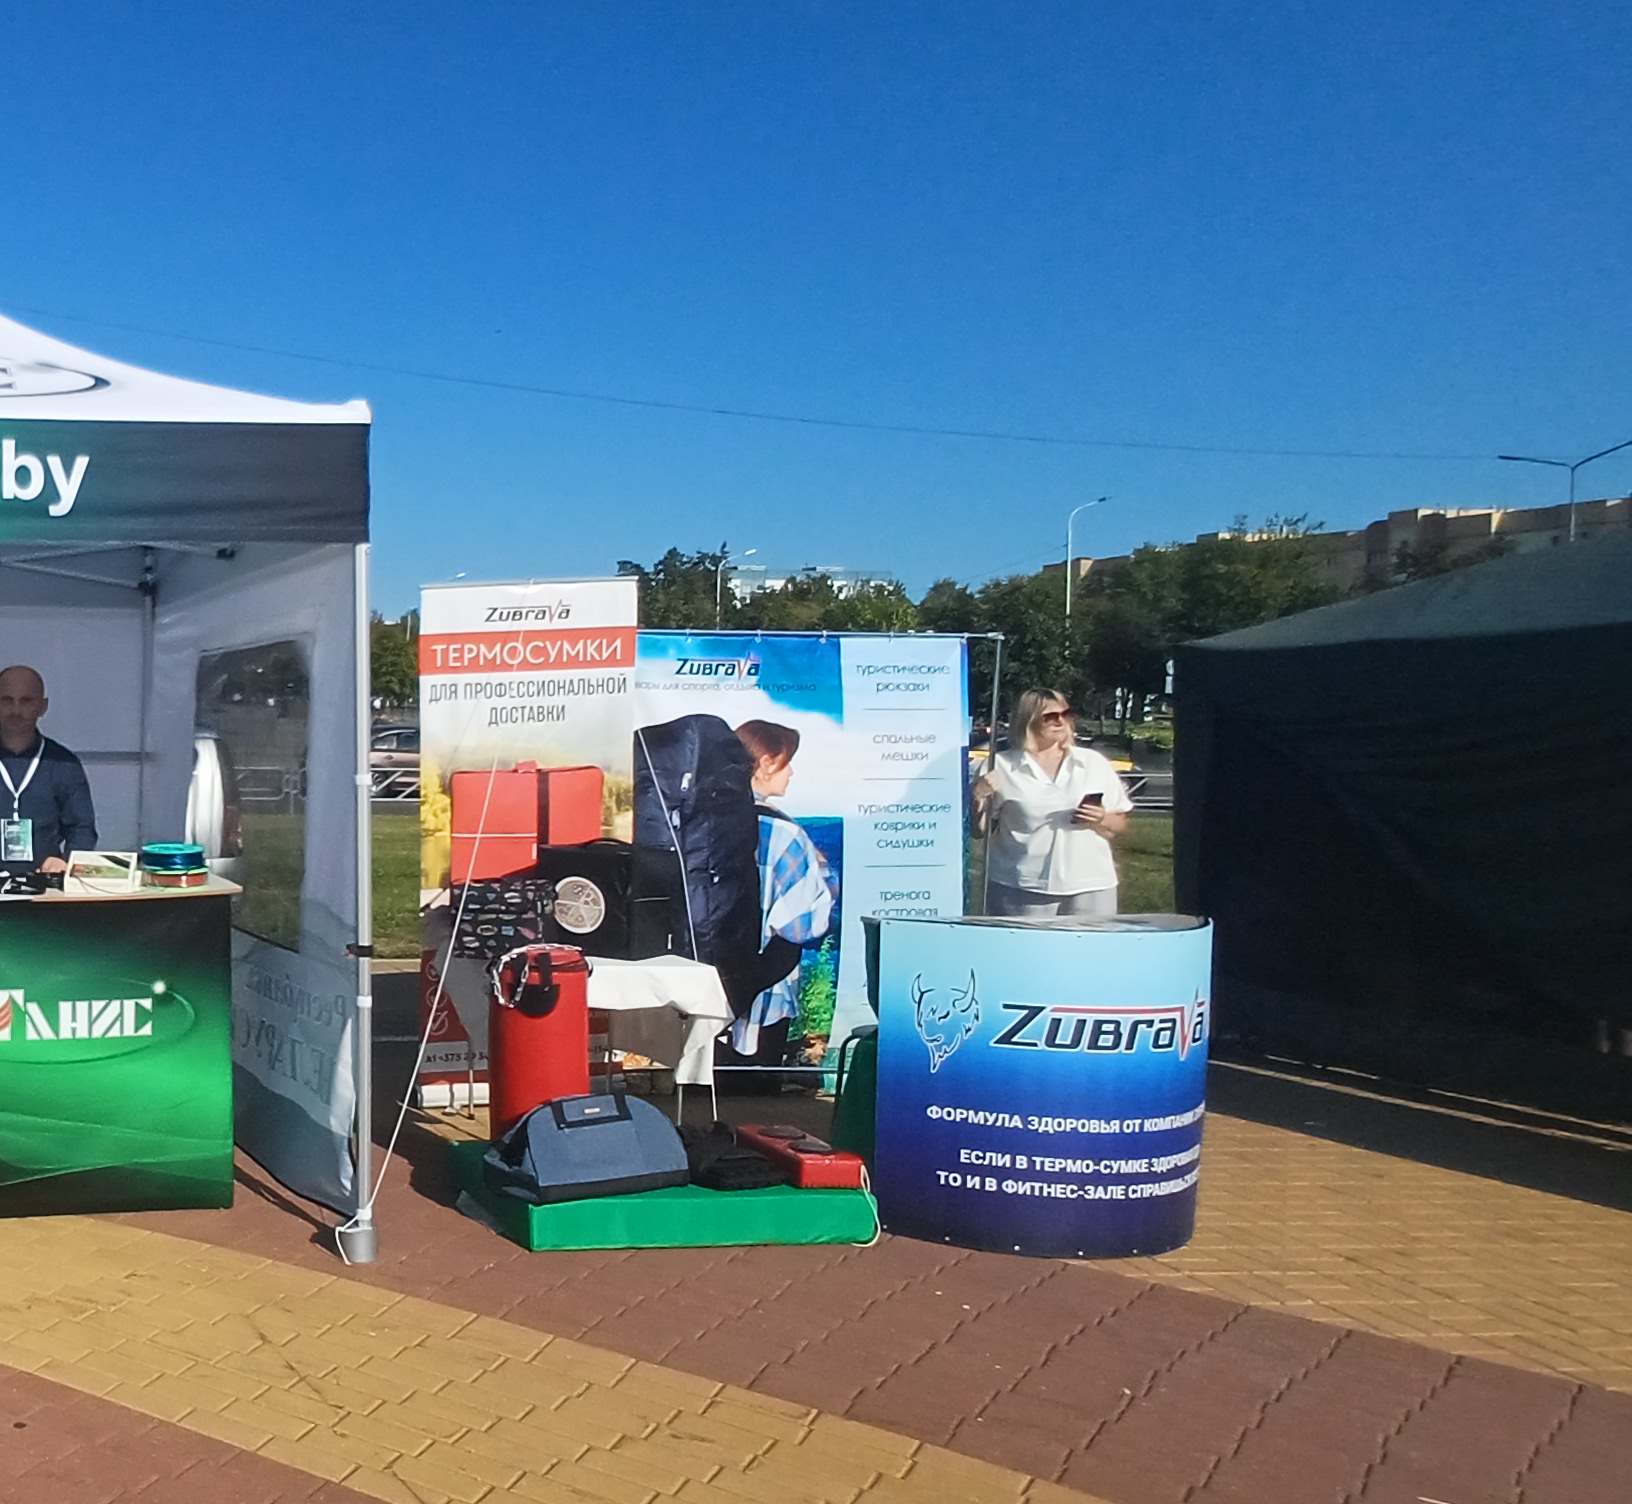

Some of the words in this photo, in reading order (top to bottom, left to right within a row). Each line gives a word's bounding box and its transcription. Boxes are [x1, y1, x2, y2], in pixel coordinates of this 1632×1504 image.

[431, 637, 623, 668] ТЕРМОСУМКИ
[855, 664, 951, 677] туристические
[429, 682, 458, 705] ДЛЯ
[464, 673, 628, 701] ПРОФЕССИОНАЛЬНОЙ
[634, 681, 661, 692] вары
[487, 704, 567, 728] ДОСТАВКИ
[872, 733, 937, 745] спальные
[880, 751, 930, 762] мешки
[857, 803, 952, 816] туристические
[873, 821, 926, 834] коврики
[876, 838, 935, 851] сидушки
[879, 890, 932, 903] тренога
[925, 1104, 1024, 1130] ФОРМУЛА
[1027, 1116, 1120, 1135] ЗДОРОВЬЯ
[1122, 1118, 1142, 1134] ОТ
[959, 1148, 1011, 1169] ЕСЛИ
[1016, 1155, 1029, 1170] В
[1031, 1156, 1150, 1175] ТЕРМО-СУМКЕ
[936, 1170, 962, 1187] ТО
[966, 1174, 981, 1190] И
[985, 1177, 997, 1192] В
[1001, 1178, 1126, 1200] ФИТНЕС-ЗАЛЕ
